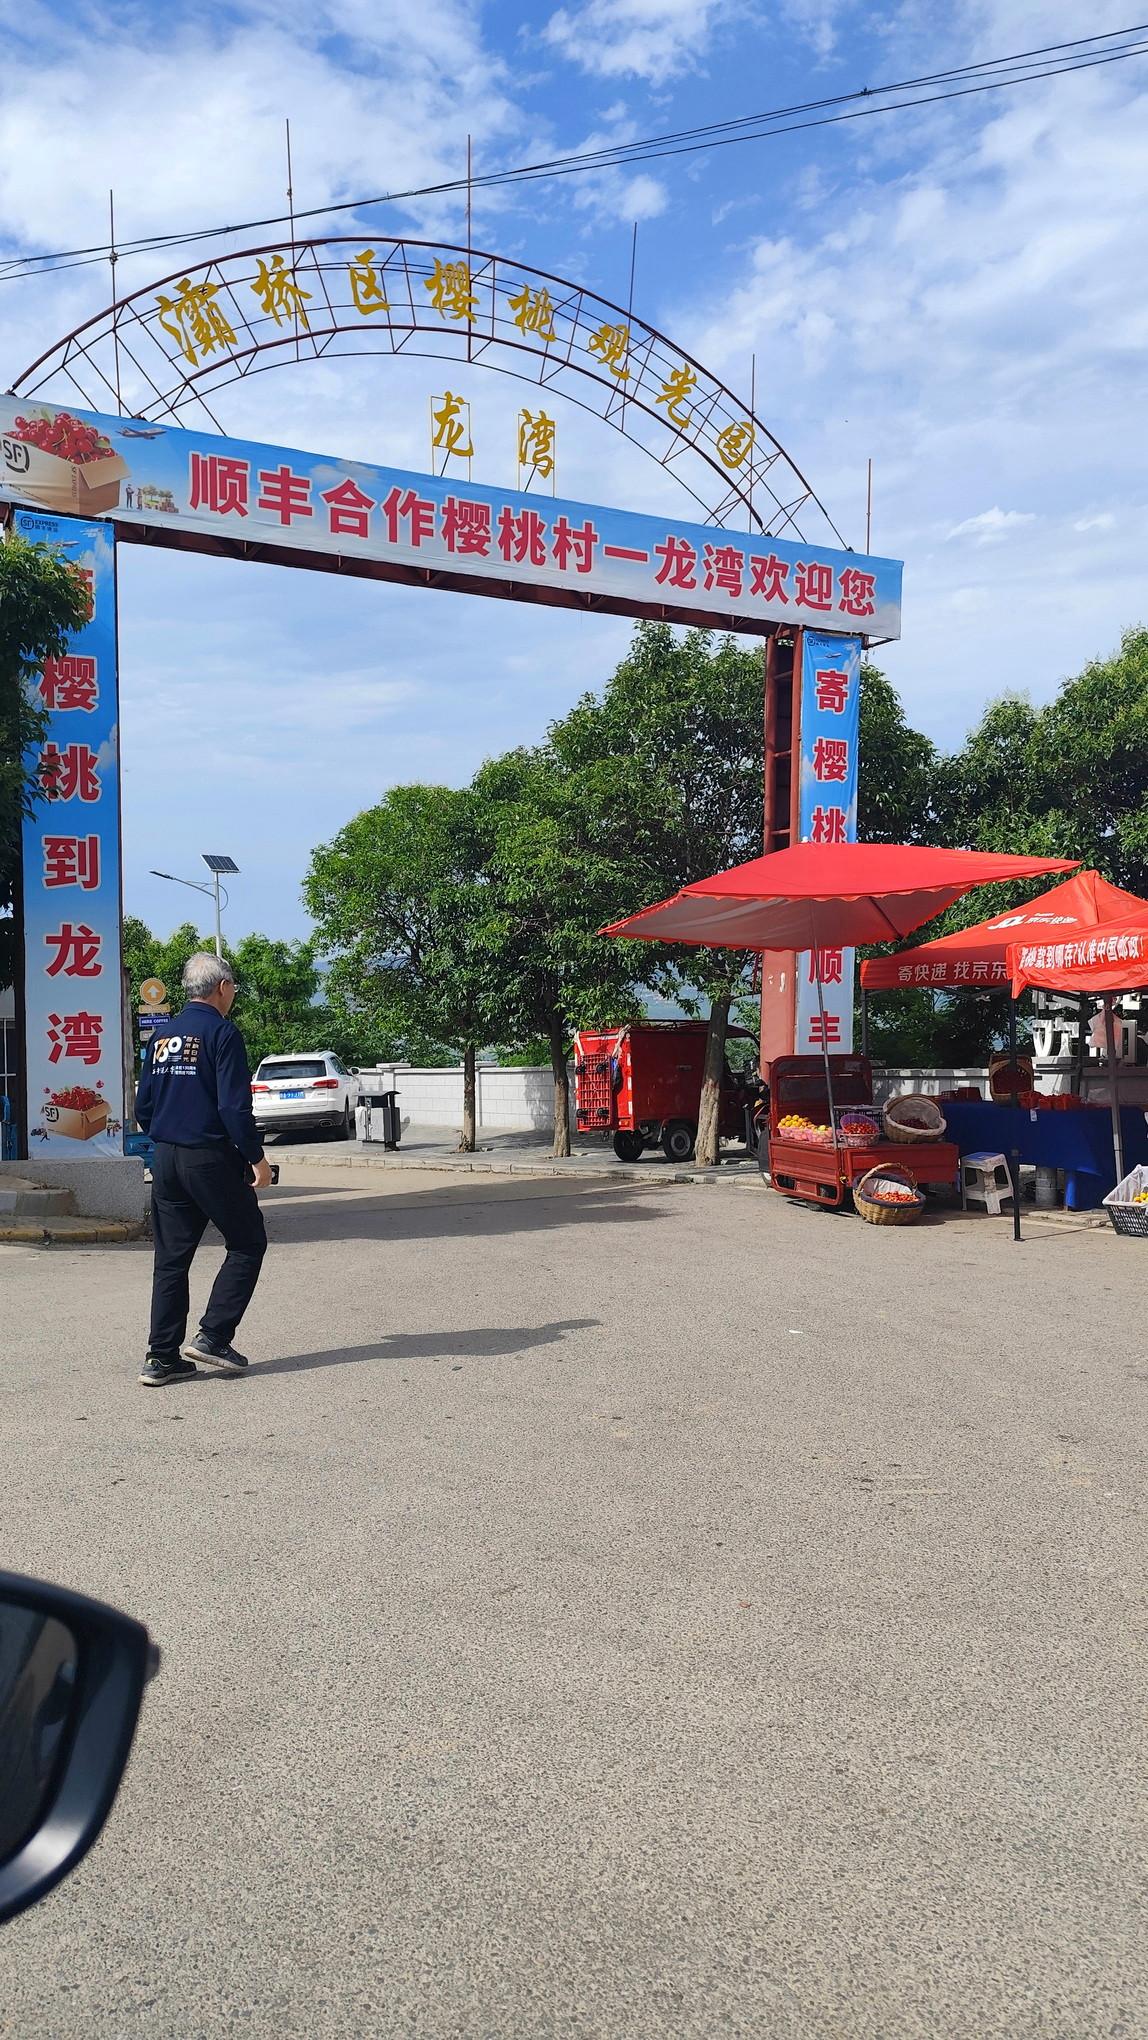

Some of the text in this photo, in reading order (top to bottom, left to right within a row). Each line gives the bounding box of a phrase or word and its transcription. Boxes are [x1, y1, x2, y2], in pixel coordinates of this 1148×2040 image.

[155, 250, 756, 469] 灞桥区樱桃观光园
[3, 440, 25, 466] SF
[434, 391, 556, 479] 龙湾
[39, 567, 104, 1065] 樱桃到龙湾
[898, 961, 1007, 982] 寄快递 找京东
